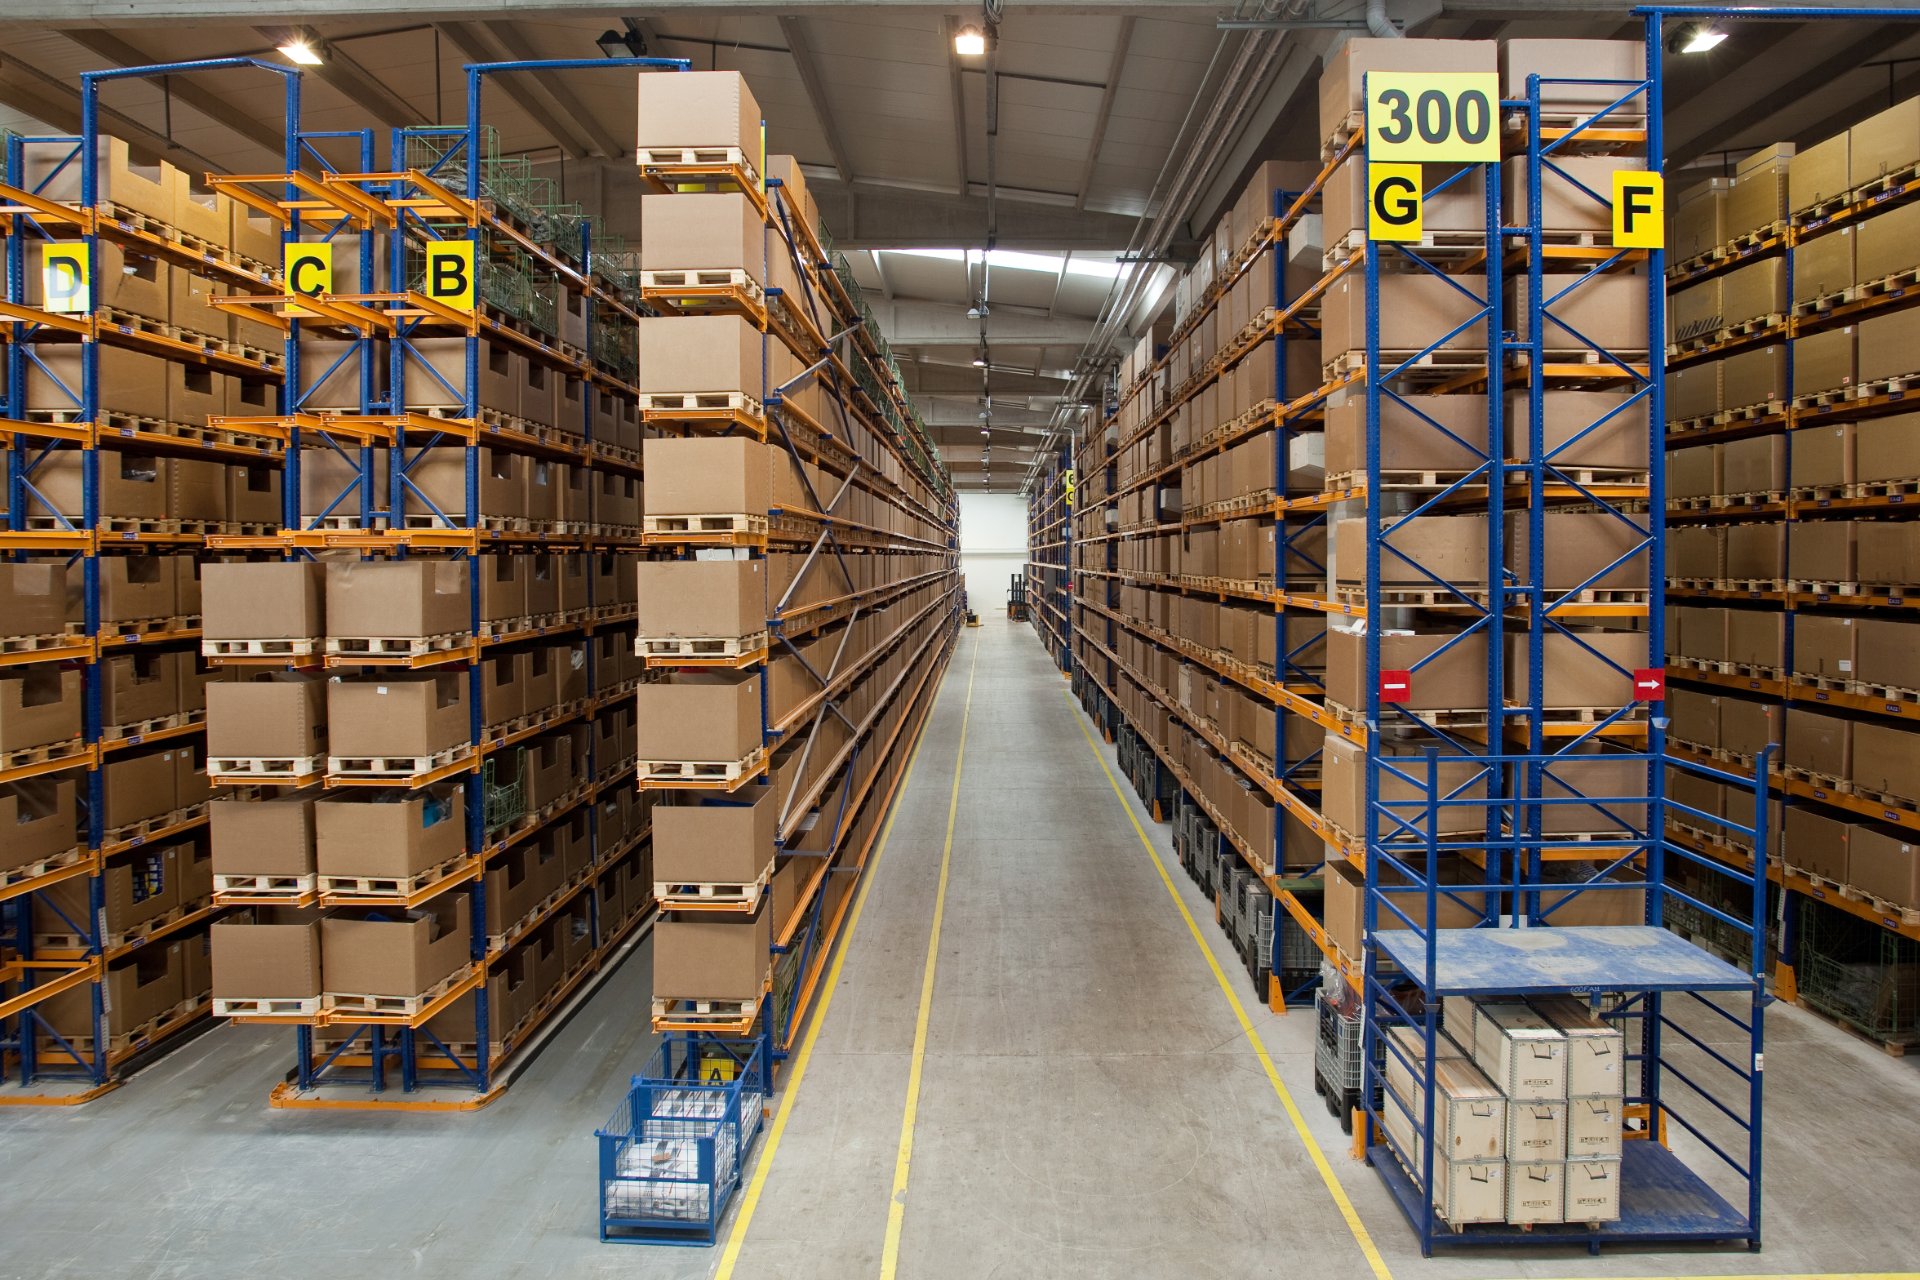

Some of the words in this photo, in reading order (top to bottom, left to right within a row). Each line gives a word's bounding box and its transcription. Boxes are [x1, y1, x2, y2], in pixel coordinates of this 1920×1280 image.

[1378, 89, 1490, 144] 300
[1374, 177, 1418, 226] G
[1623, 186, 1654, 233] F
[49, 256, 83, 298] D
[290, 256, 326, 298] C
[432, 254, 468, 297] B
[707, 1068, 724, 1086] A
